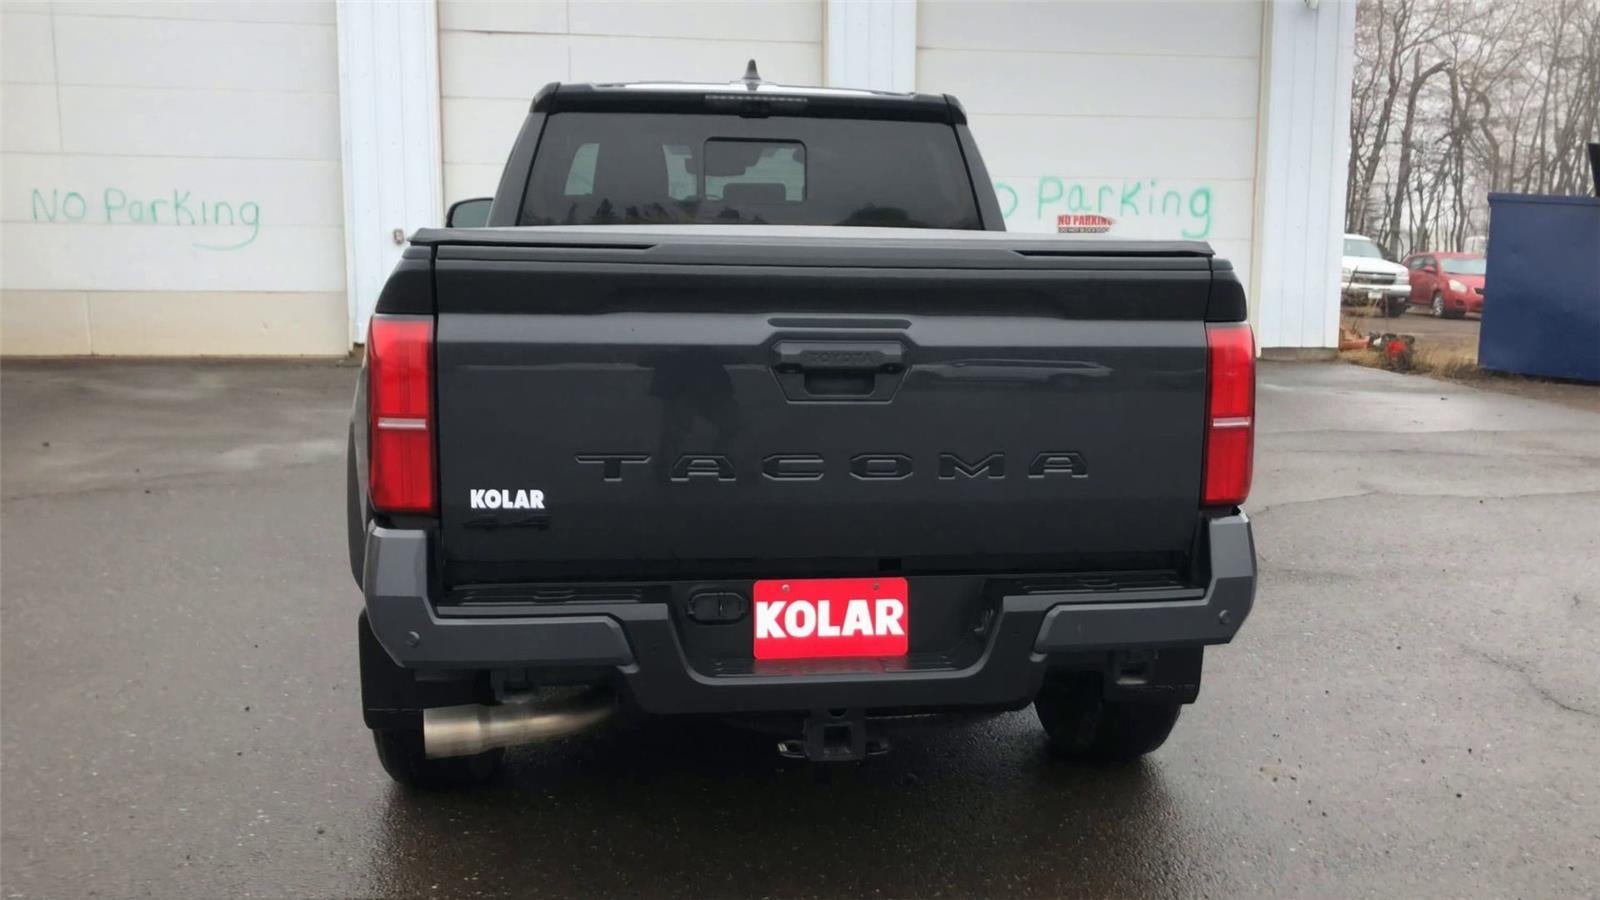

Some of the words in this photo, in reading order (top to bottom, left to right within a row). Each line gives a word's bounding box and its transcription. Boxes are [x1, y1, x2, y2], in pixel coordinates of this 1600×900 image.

[1058, 214, 1071, 226] NO
[808, 351, 875, 363] TOYOTA
[575, 451, 1089, 483] TACOMA
[470, 488, 545, 509] KOLAR
[755, 599, 905, 639] KOLAR
